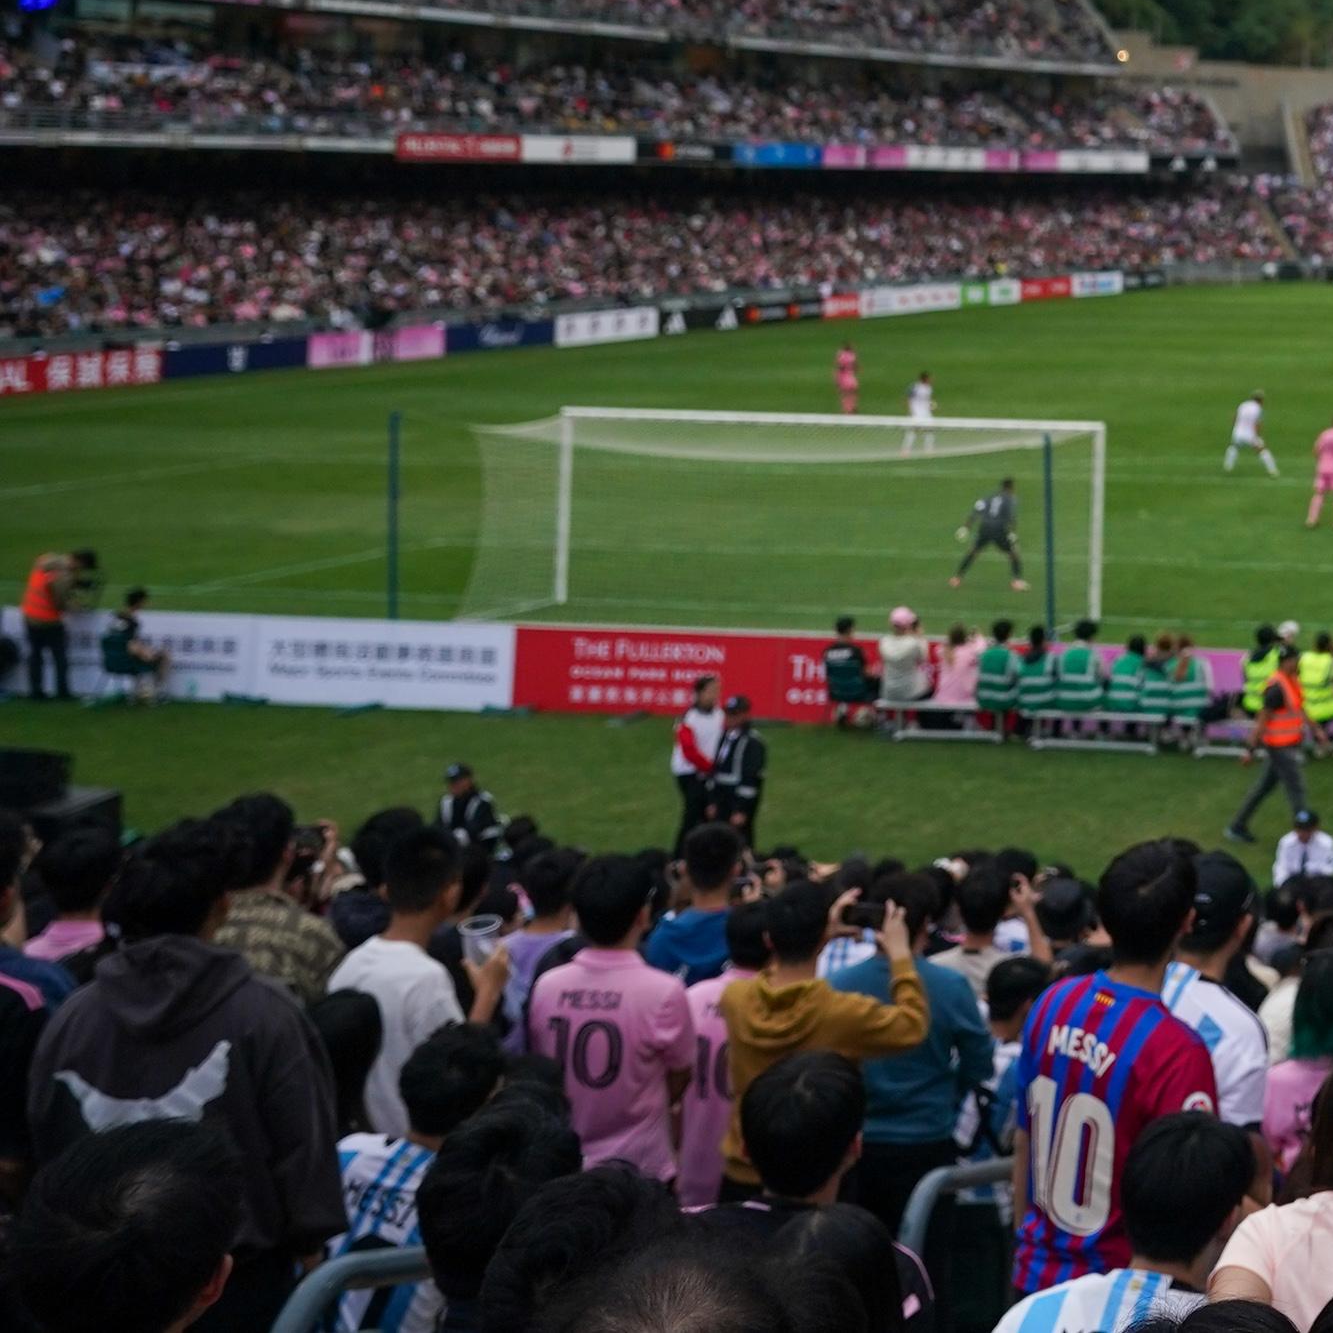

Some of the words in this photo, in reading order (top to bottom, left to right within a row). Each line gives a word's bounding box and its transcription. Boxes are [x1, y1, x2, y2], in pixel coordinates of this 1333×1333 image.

[789, 654, 826, 681] TH
[558, 989, 622, 1011] MESSI
[548, 1017, 623, 1090] 10
[1047, 1024, 1116, 1078] MESSI
[1027, 1074, 1115, 1236] 10
